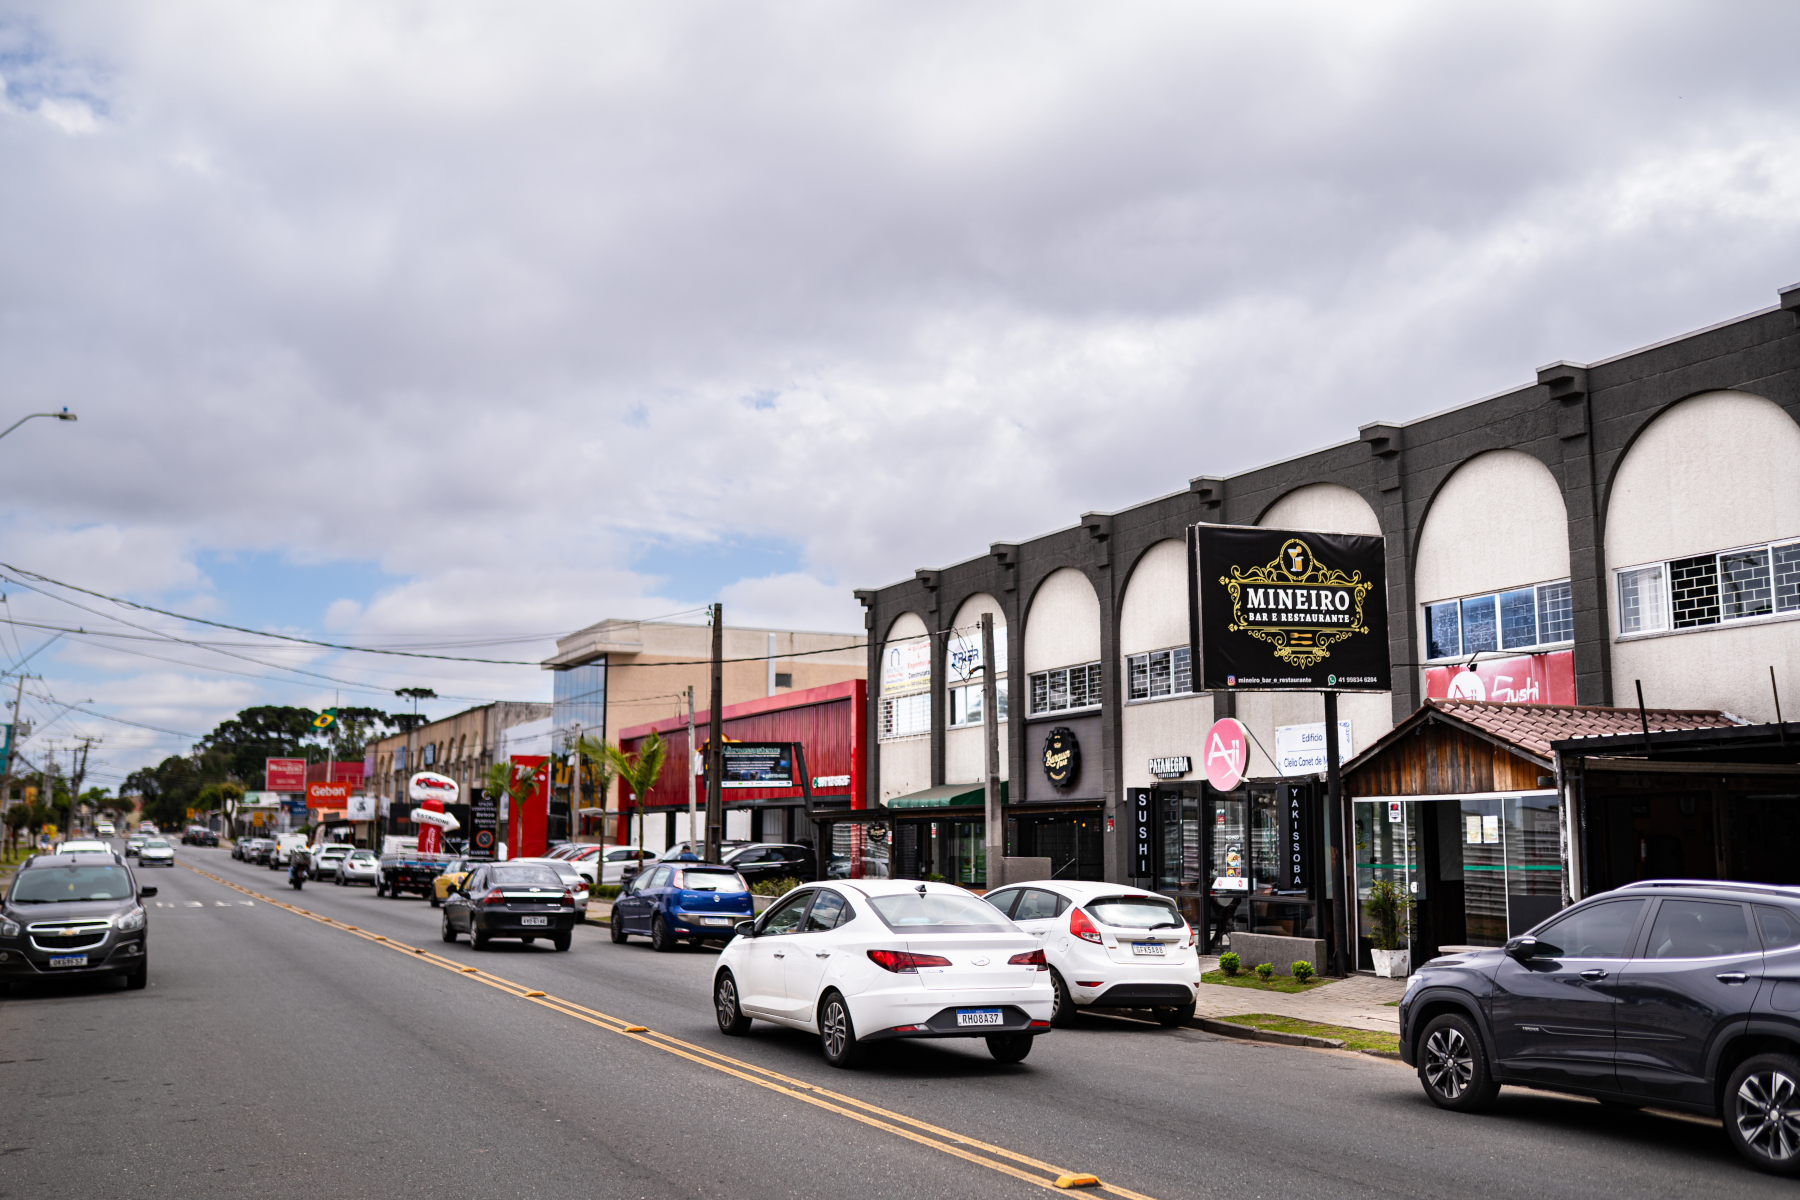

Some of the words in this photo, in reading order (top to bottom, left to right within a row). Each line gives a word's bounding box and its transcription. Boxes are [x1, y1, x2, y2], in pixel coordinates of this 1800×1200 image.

[1246, 588, 1350, 612] MINEIRO
[1248, 612, 1269, 621] BAR
[1271, 613, 1278, 621] E
[1281, 613, 1350, 623] RESTAURANTE
[1491, 675, 1540, 703] Sushi
[1149, 756, 1189, 774] PATANEGRA
[1315, 755, 1322, 766] de
[416, 812, 451, 826] ESTACIONE
[1138, 793, 1148, 872] SUSHI
[1291, 788, 1302, 885] YAKISSOBA
